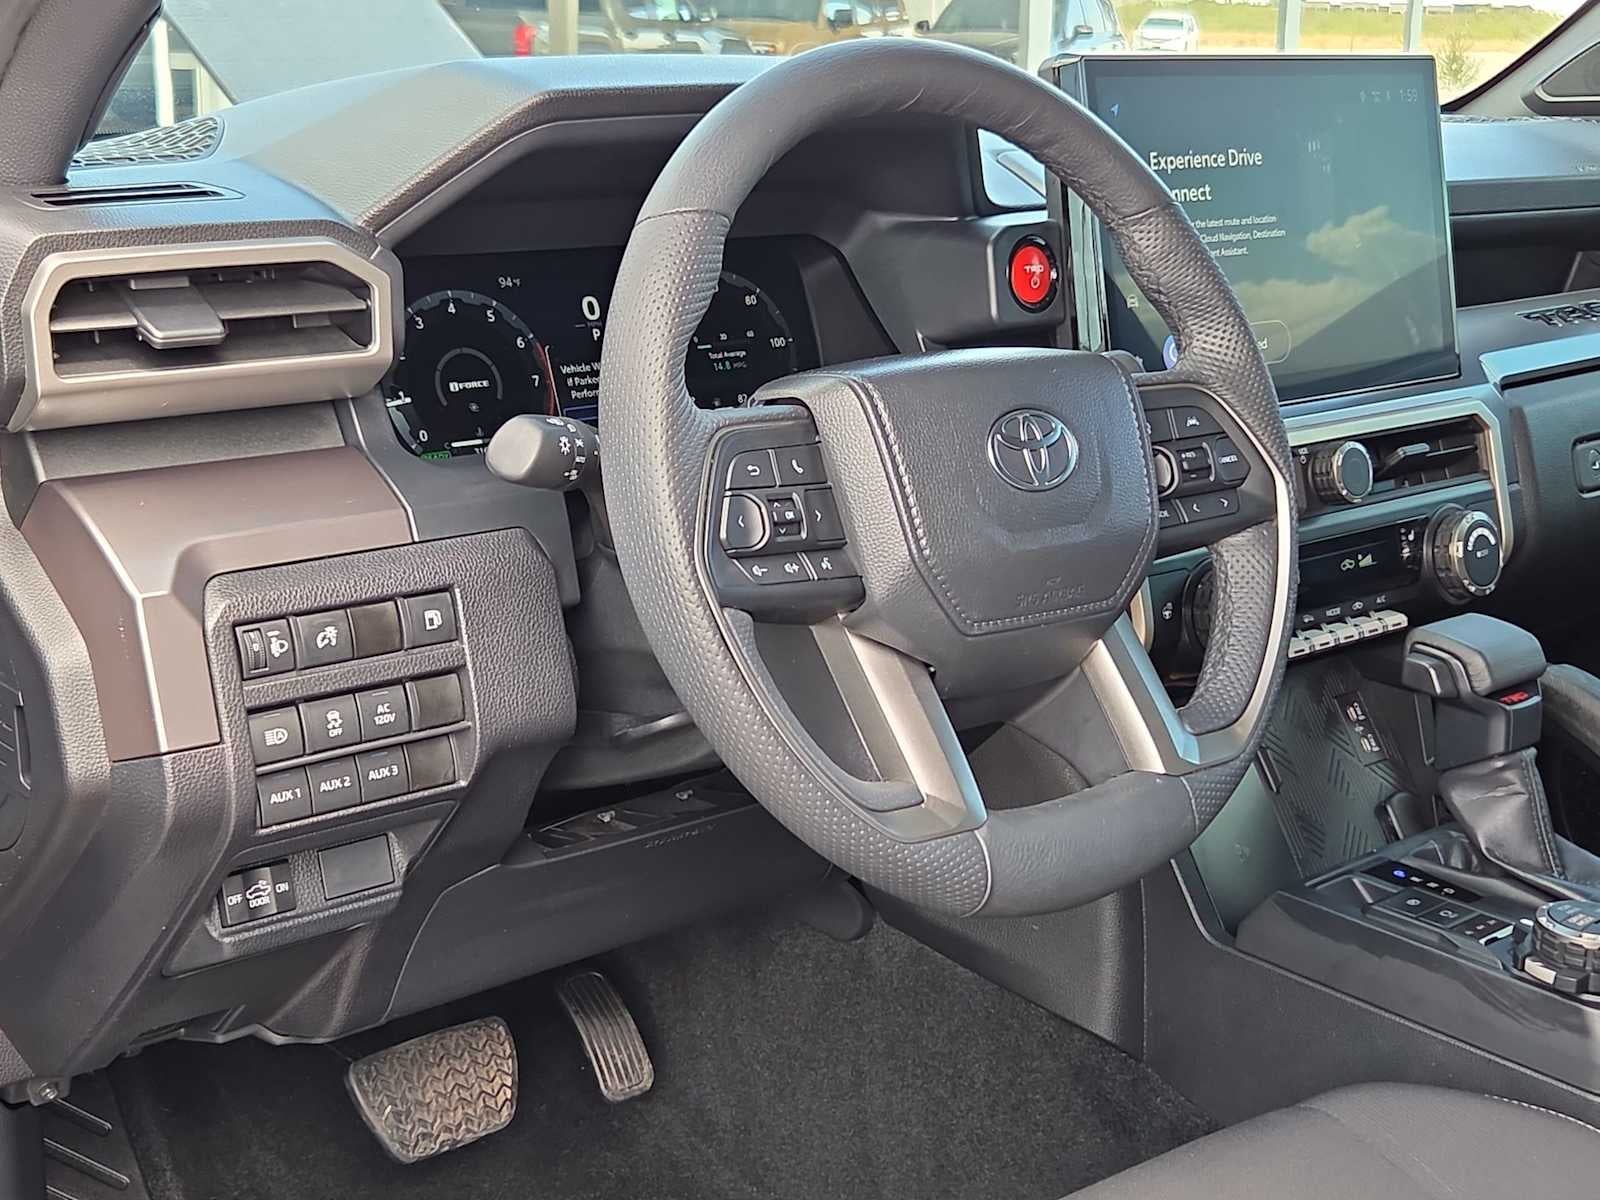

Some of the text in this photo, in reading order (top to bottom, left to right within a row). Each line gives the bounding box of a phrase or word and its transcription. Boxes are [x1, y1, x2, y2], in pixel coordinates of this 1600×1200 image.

[1149, 147, 1263, 175] Experience Drive
[1170, 183, 1212, 202] nnect
[1241, 215, 1252, 224] and
[1253, 214, 1277, 224] location
[1252, 228, 1286, 239] Destination
[447, 302, 456, 315] 4
[581, 295, 600, 321] 0
[486, 309, 496, 323] 5
[415, 316, 425, 330] 3
[591, 328, 601, 341] P
[515, 336, 526, 349] 6
[769, 337, 787, 349] 100
[560, 362, 592, 375] Vehicle
[531, 374, 541, 387] 7
[418, 429, 429, 442] 0
[376, 703, 391, 715] AC
[373, 713, 397, 726] 120V
[328, 727, 344, 738] OFF
[367, 765, 400, 782] AUX 3
[319, 776, 352, 793] AUX 2
[269, 788, 302, 805] AUX 1
[275, 881, 290, 893] ON
[227, 895, 243, 907] OFF
[248, 895, 272, 909] DOOR
